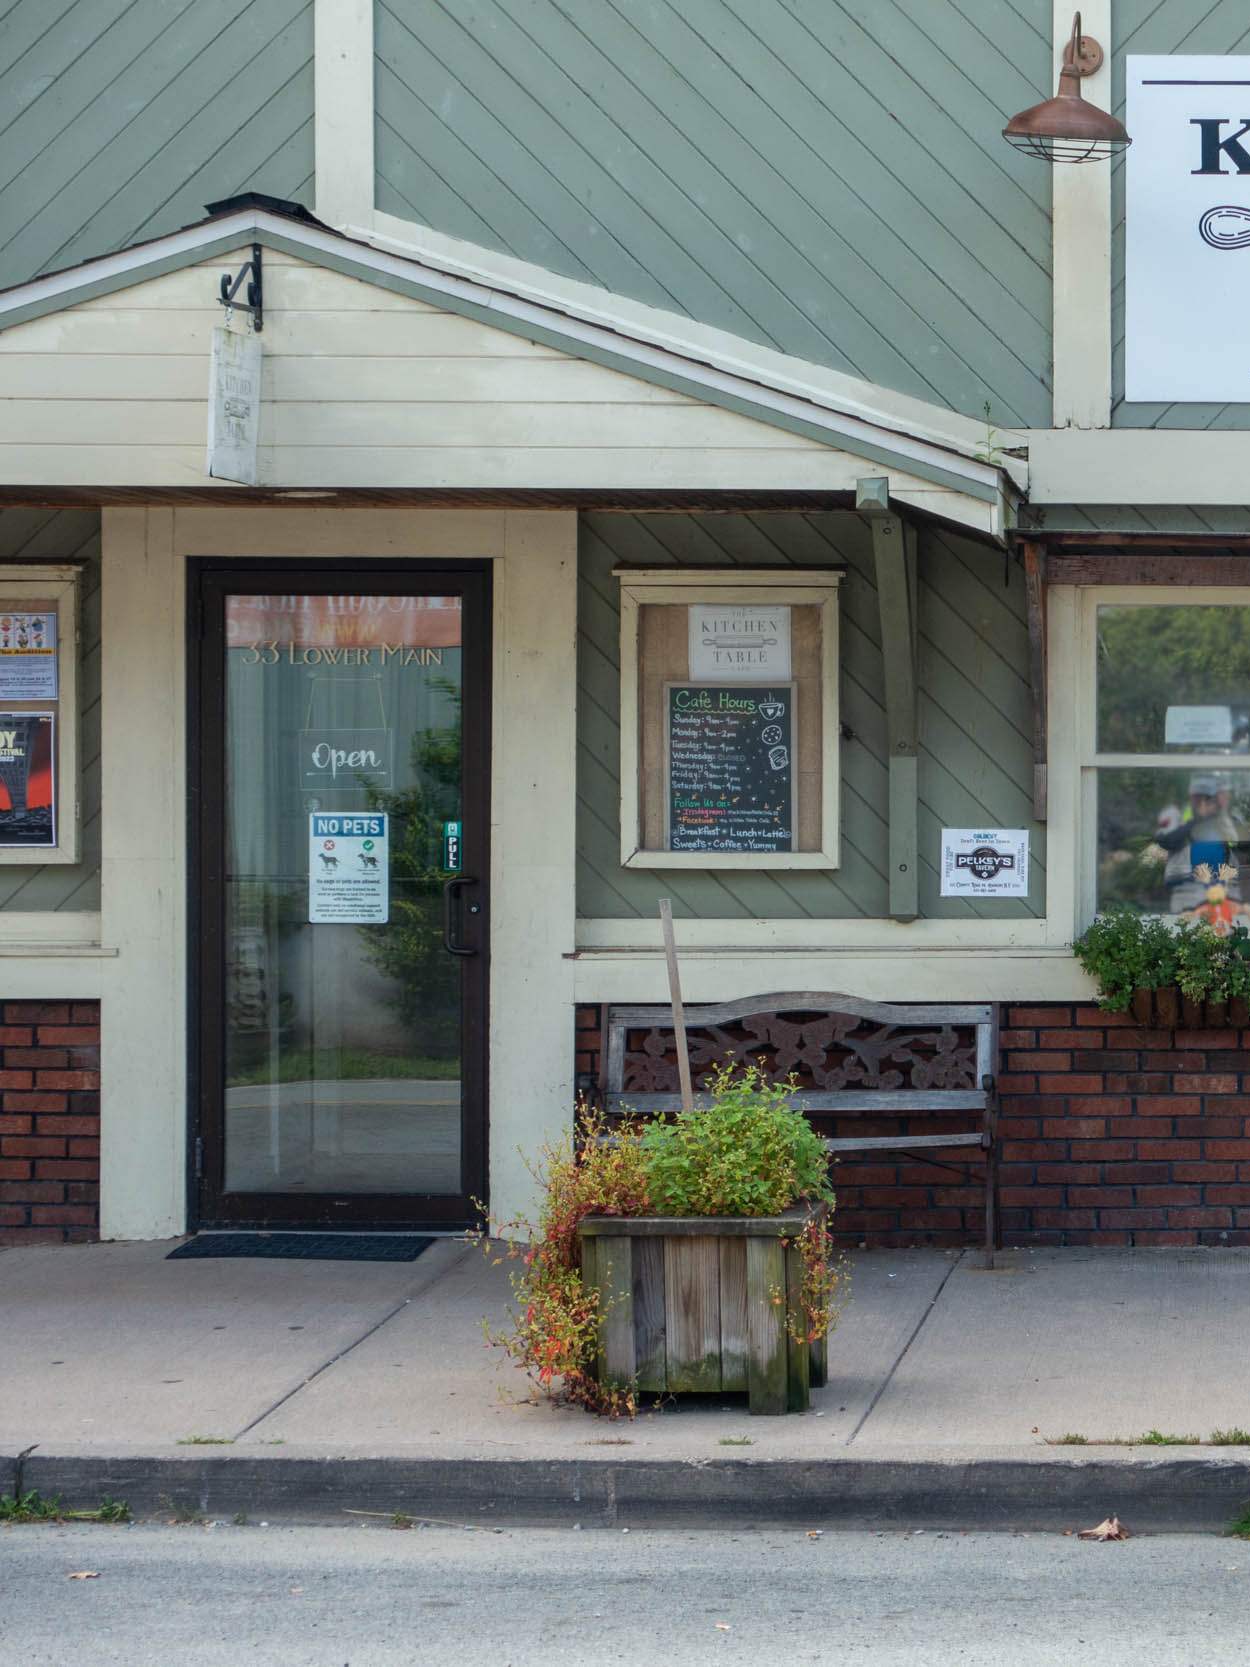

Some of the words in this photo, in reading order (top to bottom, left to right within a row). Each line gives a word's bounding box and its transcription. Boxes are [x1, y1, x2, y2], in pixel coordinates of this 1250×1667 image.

[701, 620, 778, 633] KITCHEN
[241, 641, 280, 665] 33
[713, 651, 768, 663] TABLE
[676, 690, 712, 708] Cafe
[720, 692, 756, 710] Hours
[312, 743, 381, 780] Open
[674, 797, 700, 808] Follow
[318, 819, 339, 834] NO
[343, 819, 380, 834] PETS
[679, 824, 720, 835] Breakfast
[730, 827, 757, 837] Lunch
[673, 838, 707, 849] Sweets
[713, 839, 742, 849] Coffee
[748, 839, 776, 851] Yummy
[958, 856, 1012, 866] PELKEY'S
